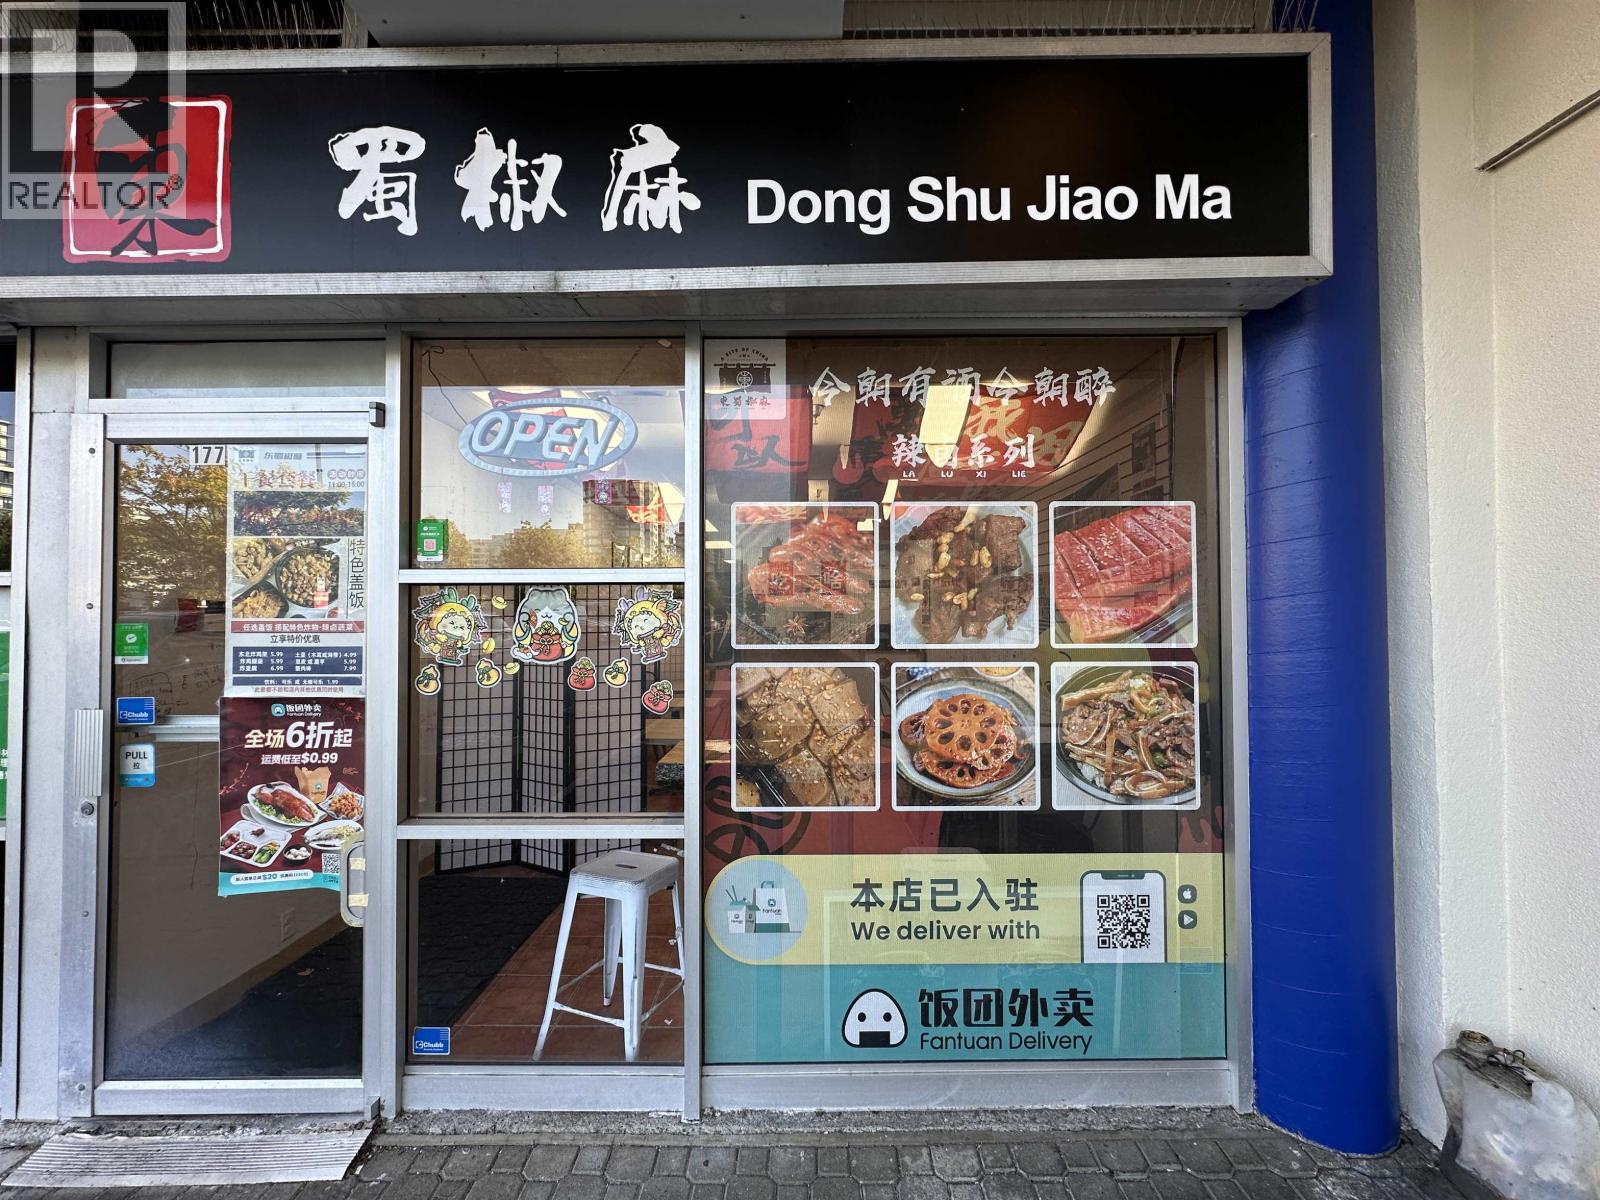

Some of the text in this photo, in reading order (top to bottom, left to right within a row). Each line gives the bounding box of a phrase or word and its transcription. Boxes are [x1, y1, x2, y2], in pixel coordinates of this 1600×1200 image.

[328, 123, 702, 236] 蜀椒麻
[747, 173, 1232, 235] Dong Shu Jiao Ma
[471, 411, 615, 467] OPEN
[192, 446, 225, 464] 177
[1011, 470, 1027, 478] LIE
[349, 539, 365, 609] 特色盖饭
[270, 634, 321, 644] 立享特价优惠
[125, 751, 149, 760] PULL
[850, 877, 1040, 913] 本店已入驻
[851, 919, 1041, 941] We deliver with
[918, 988, 1095, 1029] 饭团外卖
[920, 1031, 1094, 1055] Fantuan Delivery
